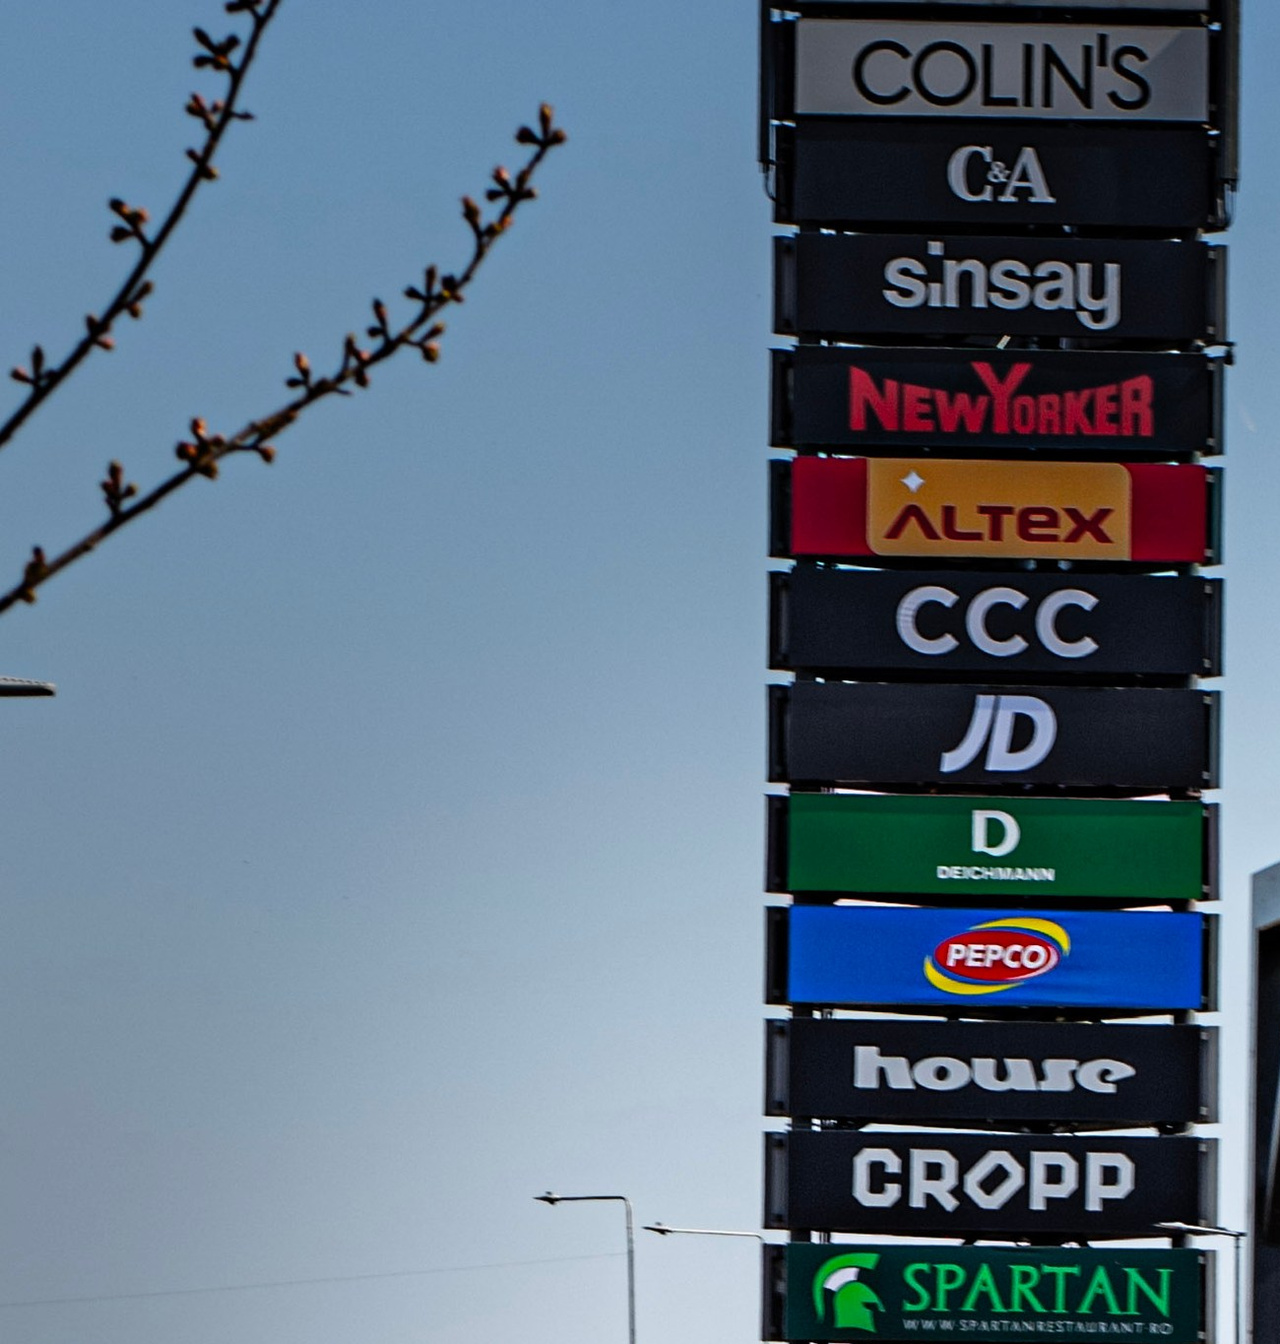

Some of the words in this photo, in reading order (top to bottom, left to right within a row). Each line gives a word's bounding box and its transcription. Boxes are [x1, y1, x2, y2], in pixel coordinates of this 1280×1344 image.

[853, 33, 1151, 110] COLIN'S
[947, 145, 1056, 203] C&A
[883, 241, 1120, 330] sinsay
[896, 585, 1100, 658] CCC
[939, 693, 1058, 773] JD
[971, 809, 1021, 857] D
[936, 865, 1056, 882] DEICHMANN
[945, 943, 1049, 970] PEPCO
[853, 1045, 1136, 1093] house
[852, 1147, 1136, 1212] CROPP
[902, 1262, 1174, 1317] SPARTAN
